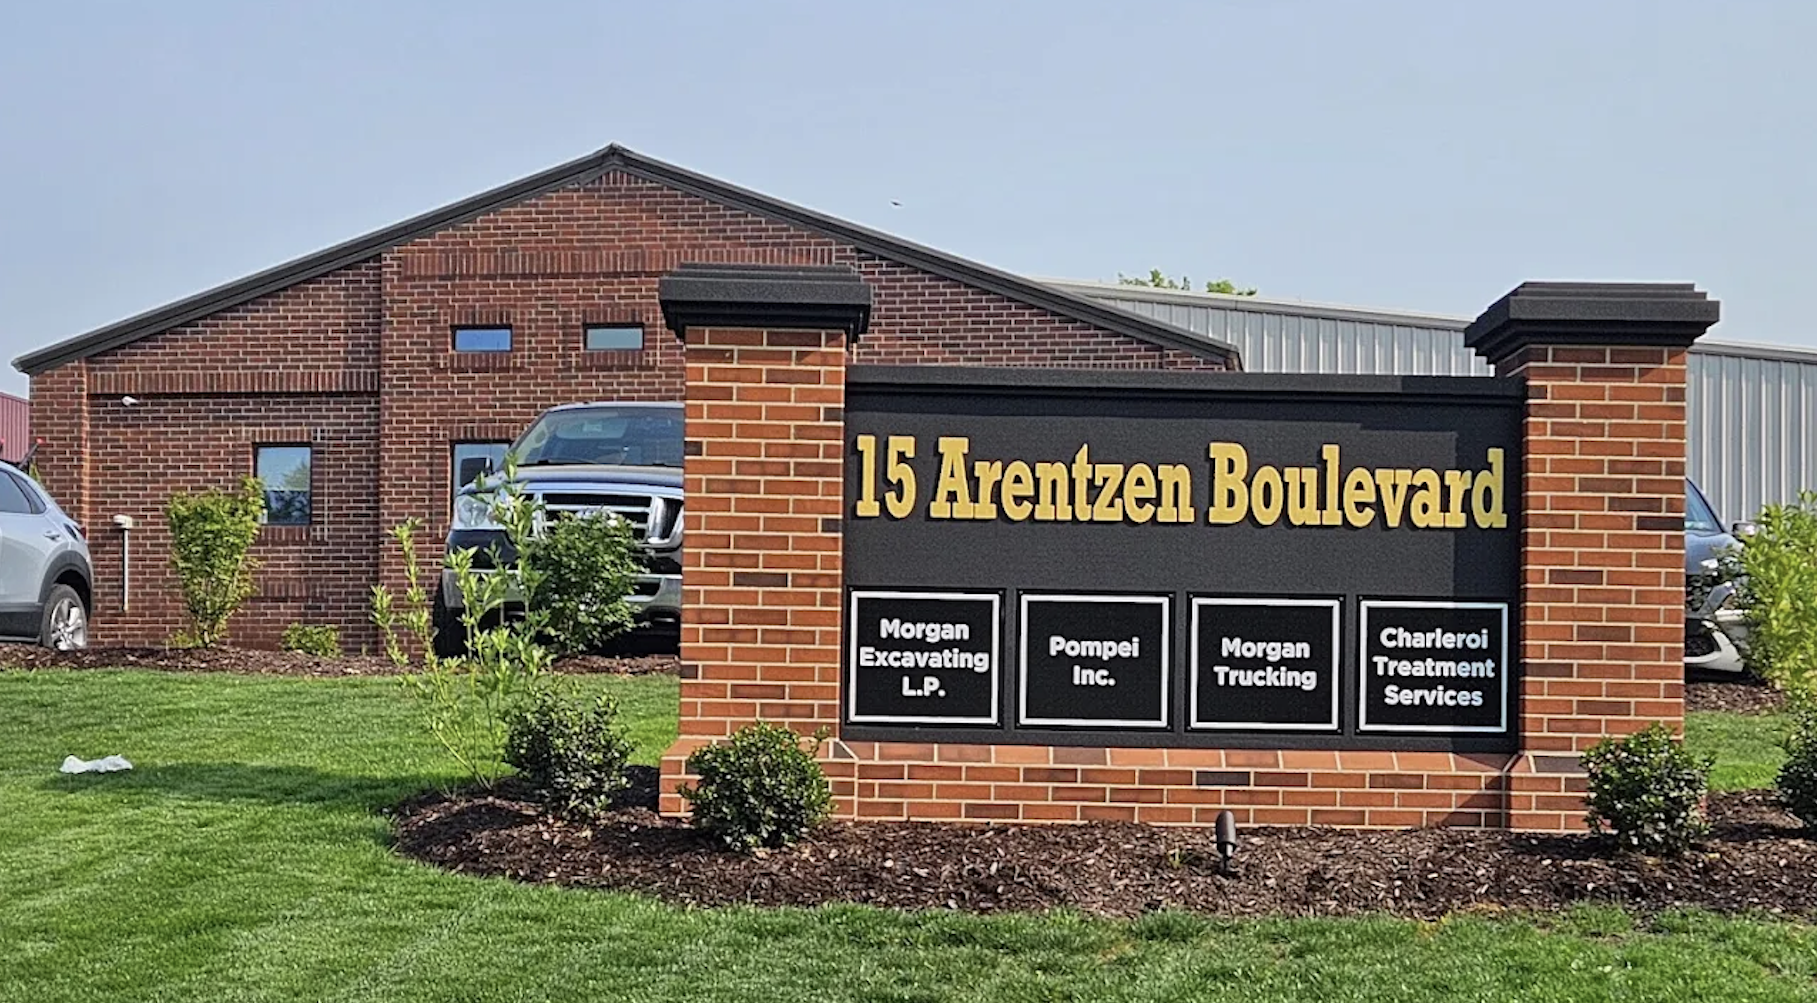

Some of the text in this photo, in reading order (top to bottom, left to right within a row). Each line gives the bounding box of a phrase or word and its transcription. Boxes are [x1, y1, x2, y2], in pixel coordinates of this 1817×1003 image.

[856, 435, 1505, 528] 15 Arentzen Boulevard
[880, 618, 970, 644] Morgan
[1379, 626, 1489, 650] Charleroi
[859, 647, 990, 672] Excavating
[1050, 635, 1140, 661] Pompei
[1221, 636, 1310, 662] Morgan
[1072, 664, 1116, 687] Inc.
[1212, 665, 1318, 691] Trucking
[1372, 655, 1496, 678] Treatment
[901, 675, 946, 697] L.P.
[1384, 684, 1483, 707] Services
